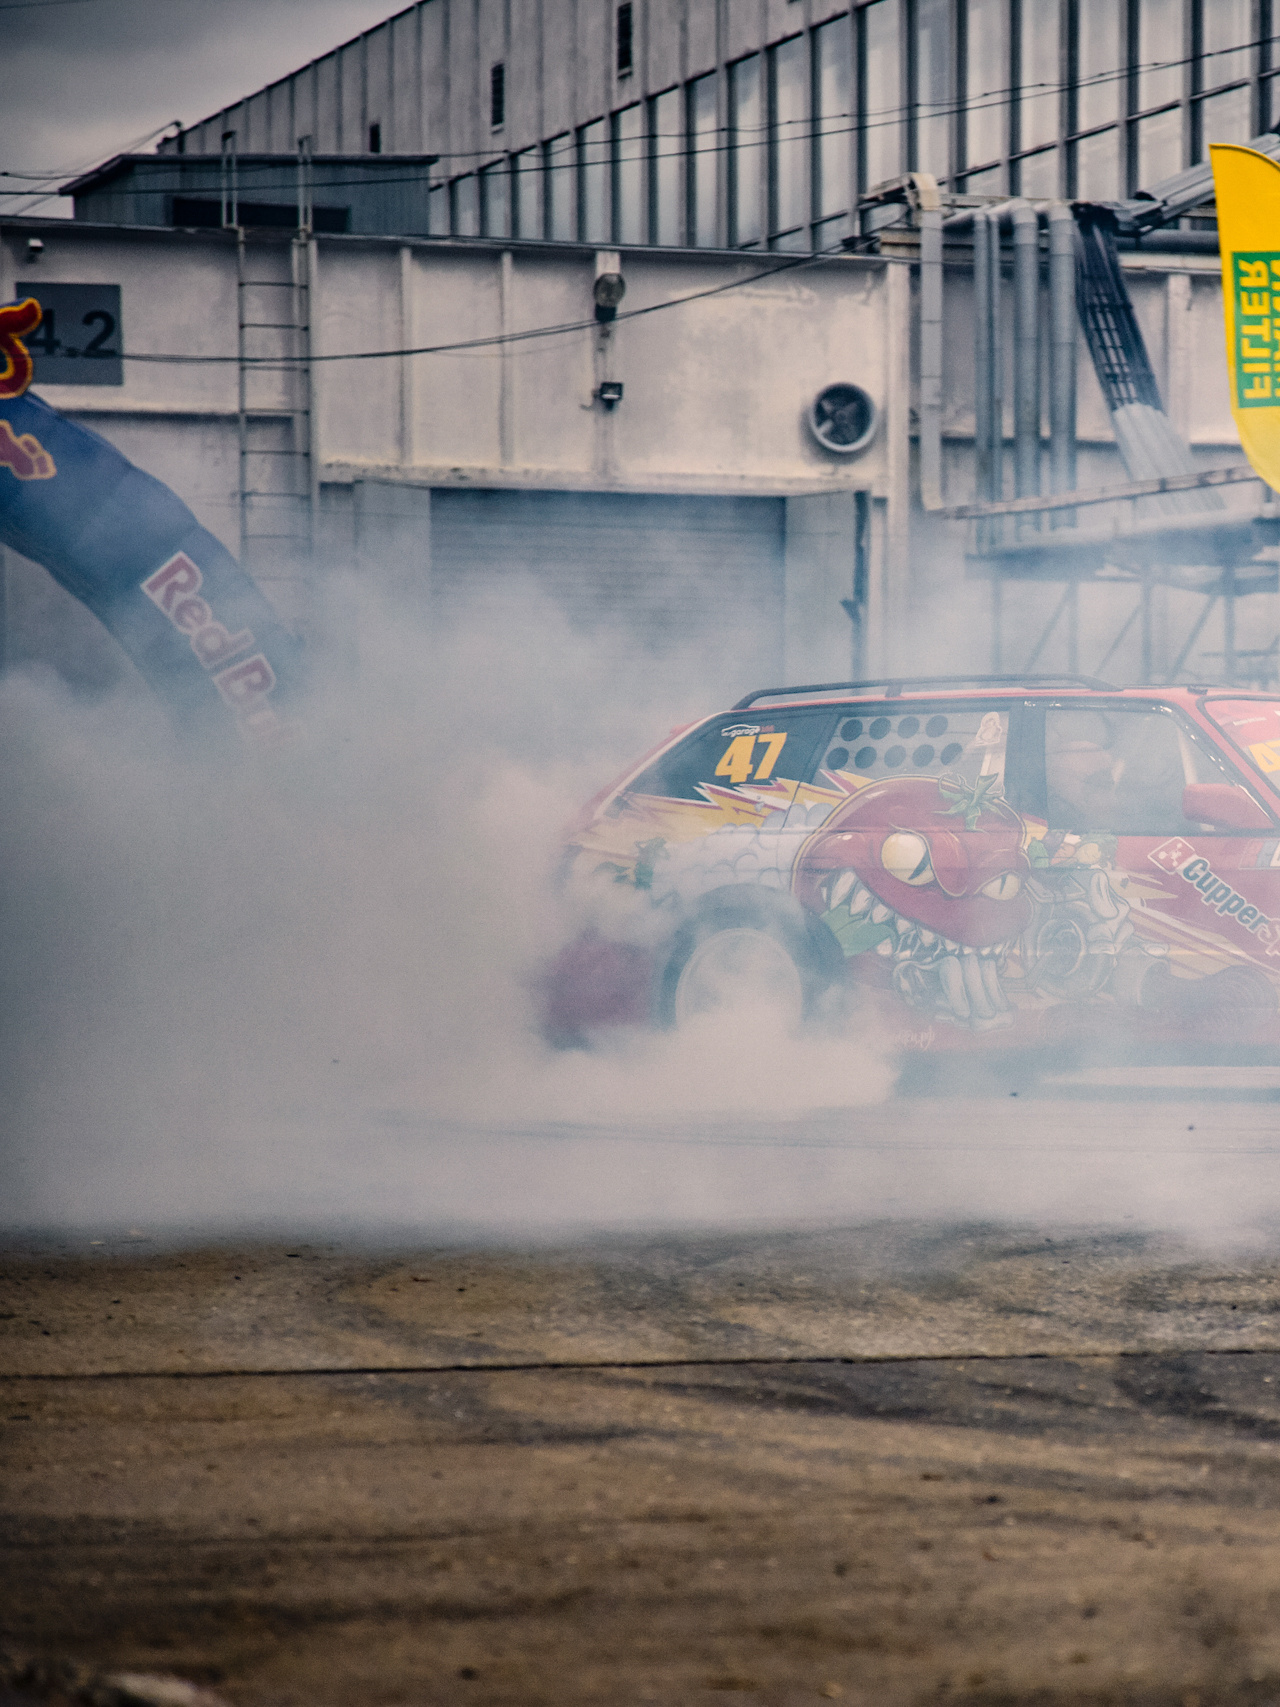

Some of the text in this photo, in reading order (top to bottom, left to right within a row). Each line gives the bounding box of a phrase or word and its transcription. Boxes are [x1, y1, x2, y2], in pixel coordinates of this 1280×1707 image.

[25, 308, 116, 357] 4.2
[140, 551, 256, 671] Red
[715, 732, 788, 784] 47
